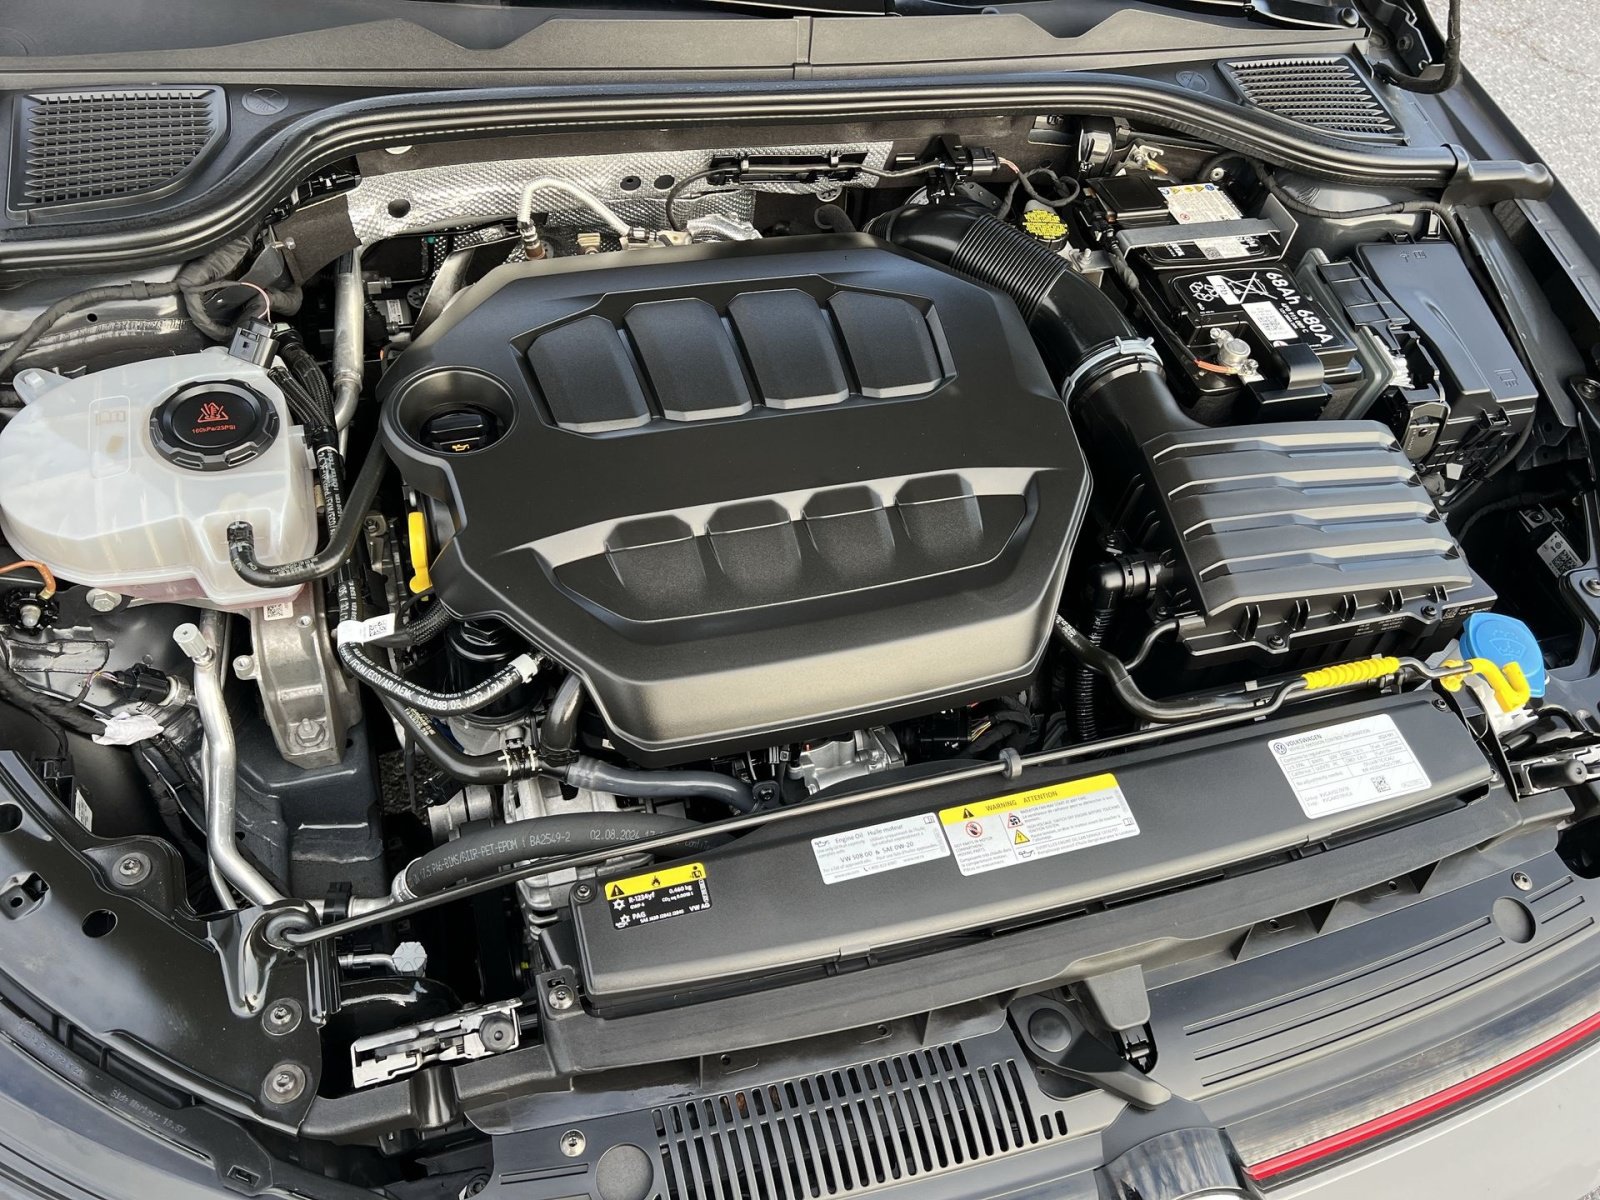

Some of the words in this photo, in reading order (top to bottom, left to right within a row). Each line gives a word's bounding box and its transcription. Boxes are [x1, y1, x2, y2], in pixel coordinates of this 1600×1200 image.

[1215, 284, 1228, 296] Pb
[1265, 272, 1300, 305] 68Ah
[1296, 309, 1333, 344] 680A
[1286, 733, 1322, 747] VOLKSWAGEN
[985, 799, 1017, 811] WARNING
[1022, 790, 1058, 803] ATTENTION
[867, 828, 882, 836] Huile
[882, 823, 903, 832] moteur
[530, 831, 571, 846] BA2549-2
[834, 835, 854, 844] Engine
[628, 891, 655, 903] R-1234yf
[632, 911, 647, 920] PAG
[689, 904, 700, 912] VW
[701, 902, 711, 910] AG
